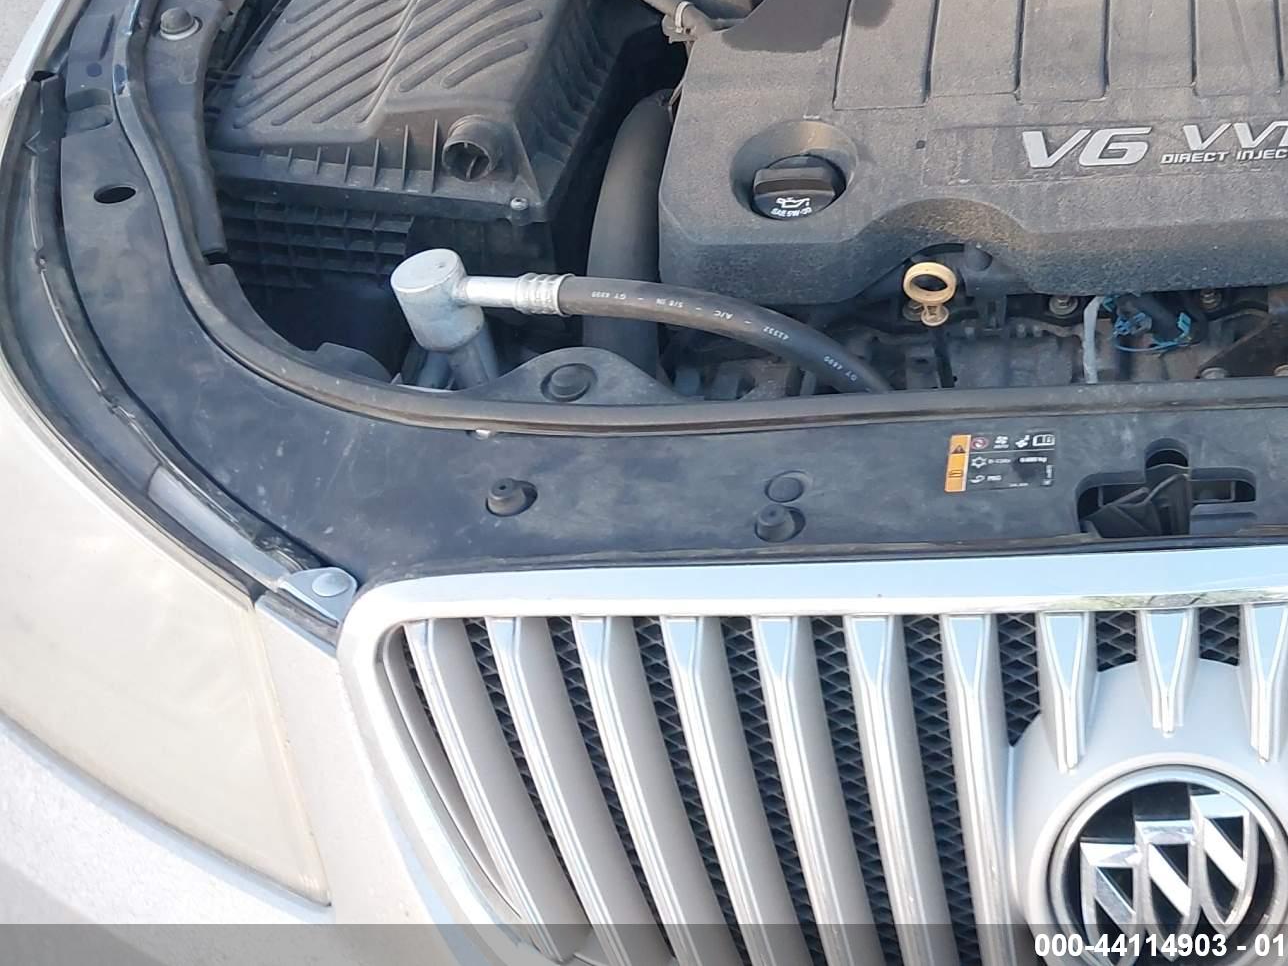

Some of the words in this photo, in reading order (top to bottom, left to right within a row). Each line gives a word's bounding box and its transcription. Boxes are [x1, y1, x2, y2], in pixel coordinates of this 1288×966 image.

[1022, 126, 1153, 168] V6
[1160, 151, 1233, 164] DIRECT
[713, 310, 733, 320] A/C
